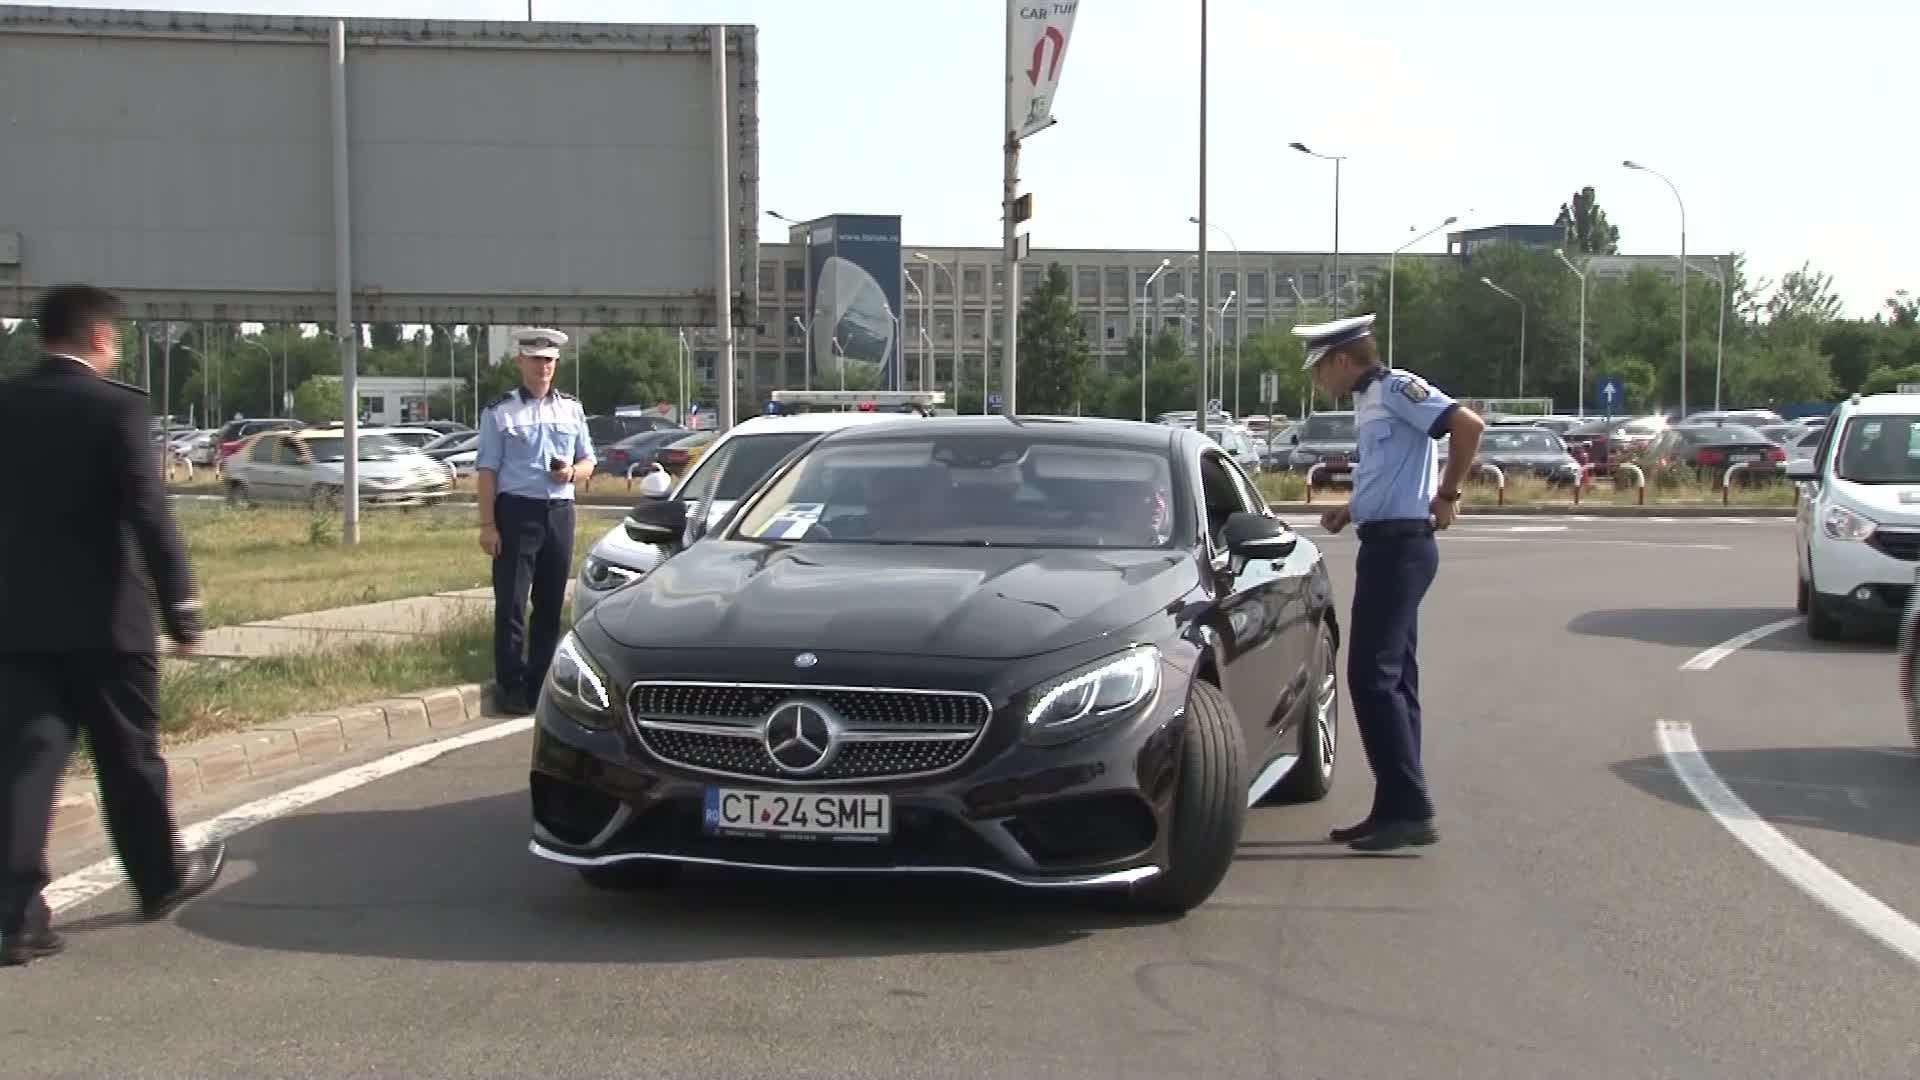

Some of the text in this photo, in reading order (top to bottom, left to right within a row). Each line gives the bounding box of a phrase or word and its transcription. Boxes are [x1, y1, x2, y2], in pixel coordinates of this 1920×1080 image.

[1020, 6, 1048, 20] CAR
[722, 793, 883, 829] CT 24 SMH
